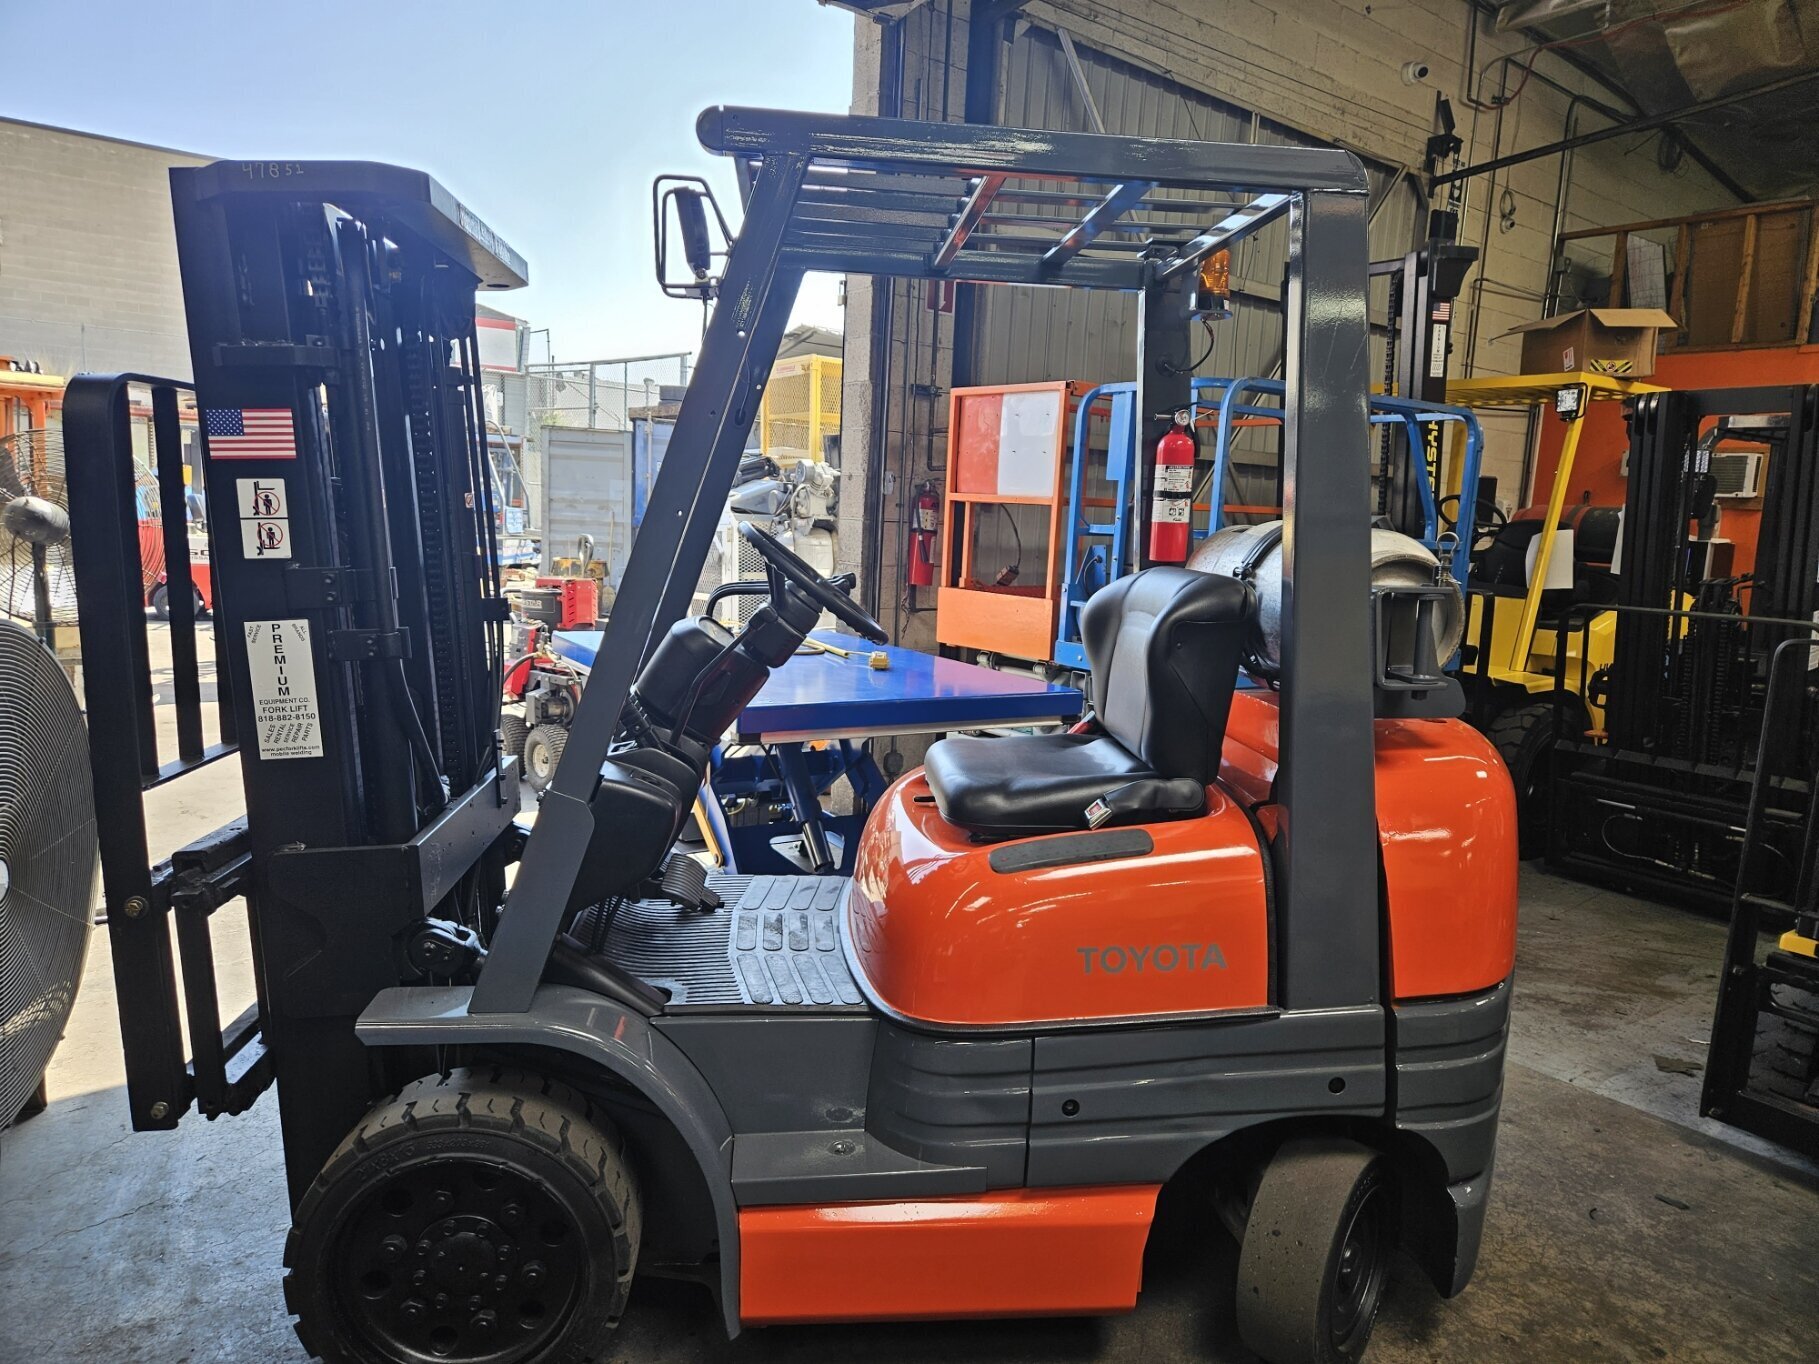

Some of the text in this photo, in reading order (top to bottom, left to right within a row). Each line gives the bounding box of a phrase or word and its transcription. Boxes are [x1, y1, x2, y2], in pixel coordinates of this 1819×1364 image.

[1426, 420, 1438, 500] HYSTE
[246, 625, 254, 639] FAST
[251, 624, 262, 644] SERVICE
[271, 623, 290, 696] PREMIUM
[259, 698, 297, 706] EQUIPMENT
[262, 706, 288, 714] FORK
[258, 713, 316, 722] 818-882-8150
[264, 724, 276, 744] SALES
[273, 724, 287, 744] RENTAL
[283, 723, 295, 743] SERVICE
[291, 723, 304, 743] REPAIR
[302, 722, 313, 742] PARTS
[1077, 944, 1228, 975] TOYOTA
